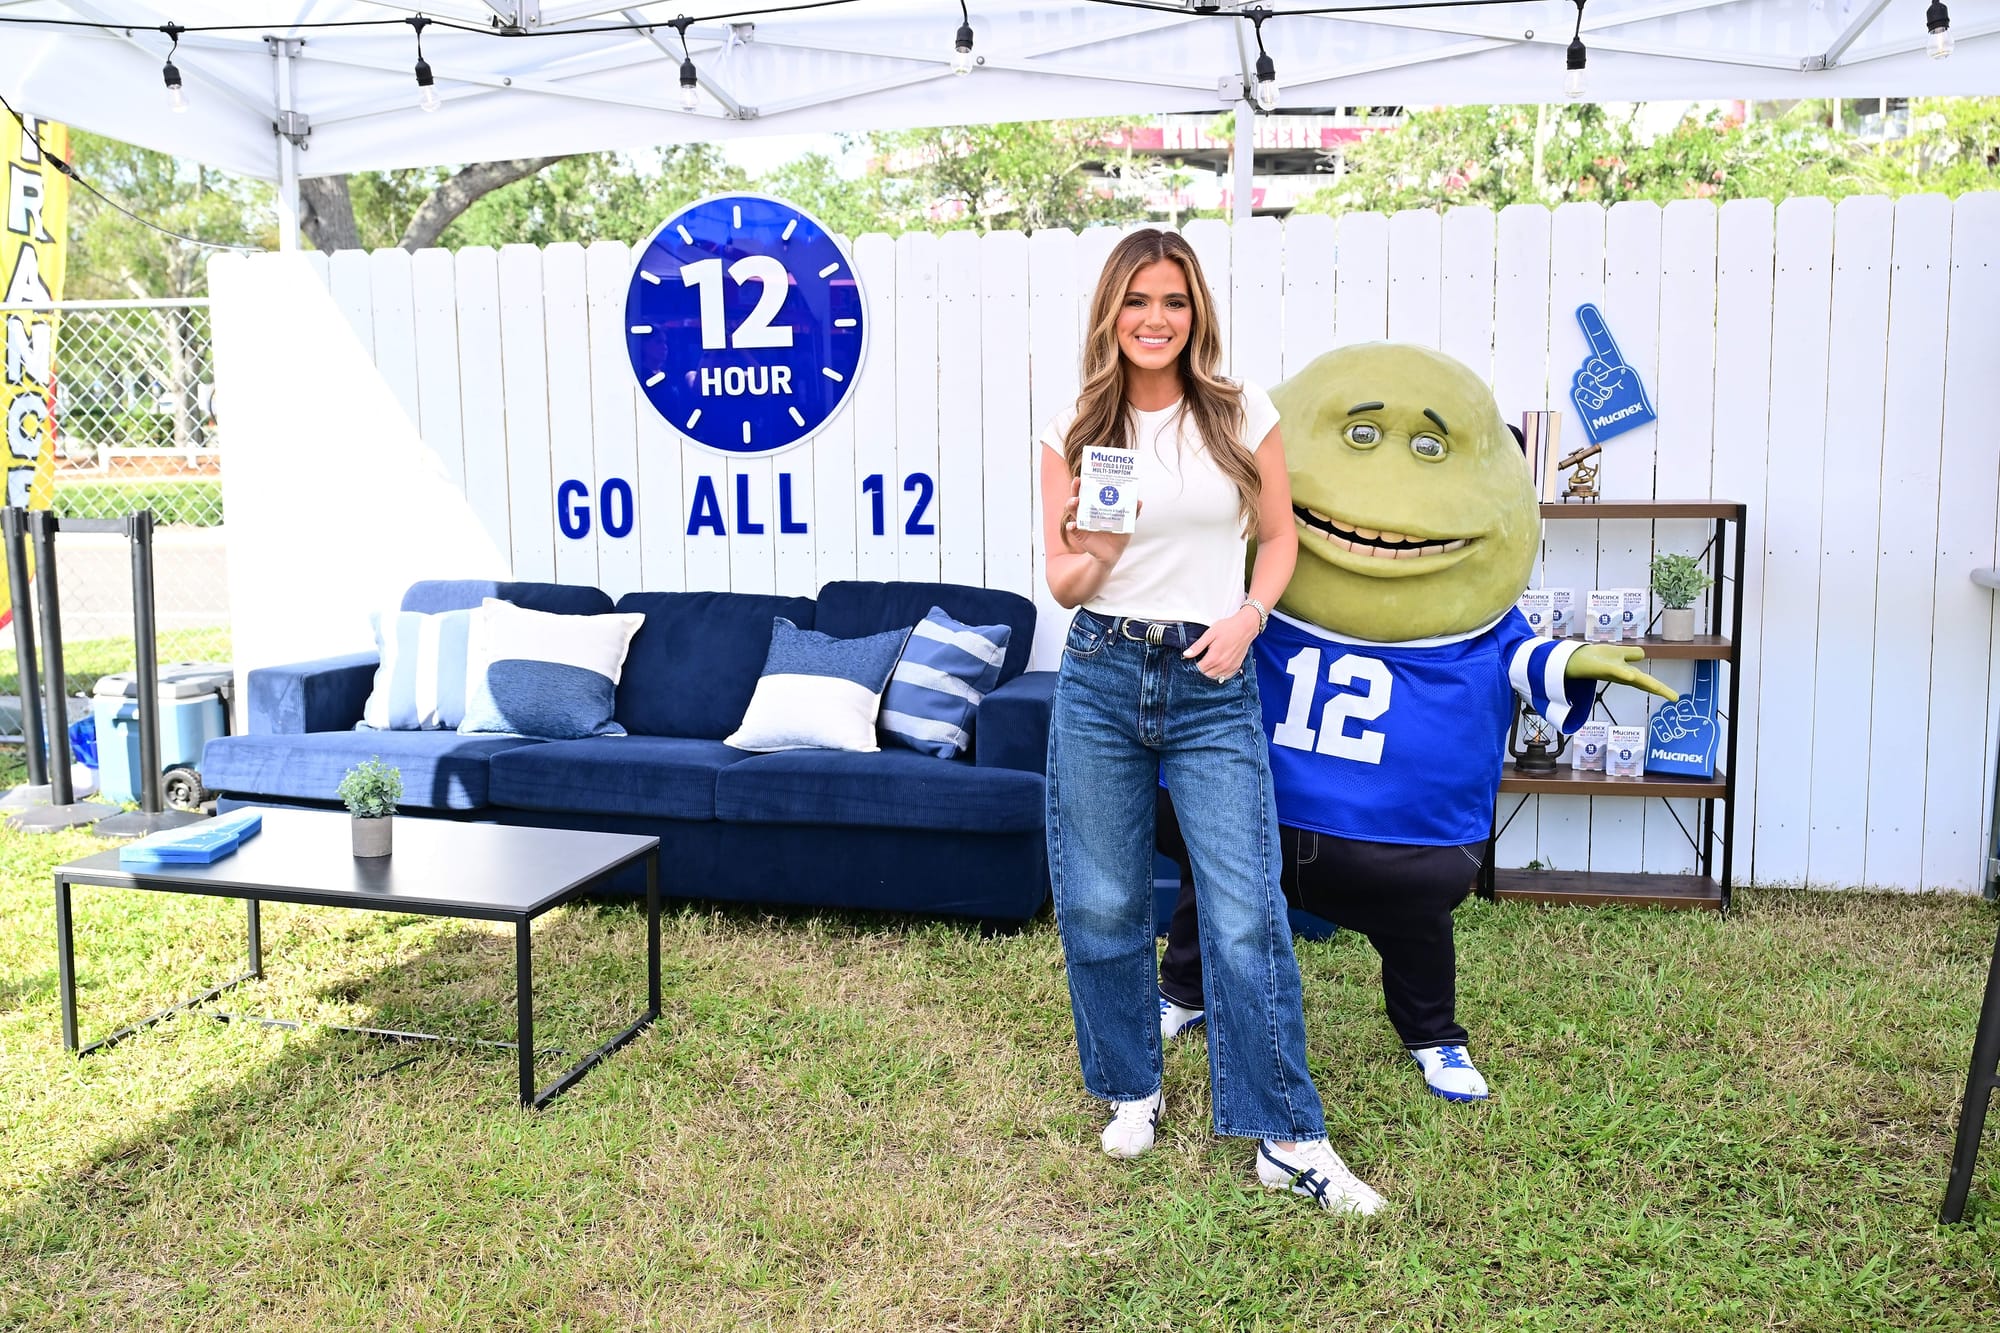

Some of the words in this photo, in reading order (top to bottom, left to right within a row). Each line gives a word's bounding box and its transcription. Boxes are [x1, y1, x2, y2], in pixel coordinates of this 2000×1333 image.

[679, 255, 793, 350] 12
[700, 365, 793, 397] HOUR
[1592, 402, 1643, 430] Mucinex
[1091, 451, 1134, 464] Mucinex
[557, 477, 634, 540] GO
[686, 473, 808, 536] ALL
[862, 472, 935, 536] 12
[1104, 489, 1114, 499] 12
[1272, 647, 1394, 765] 12
[1651, 748, 1703, 764] Mucinex
